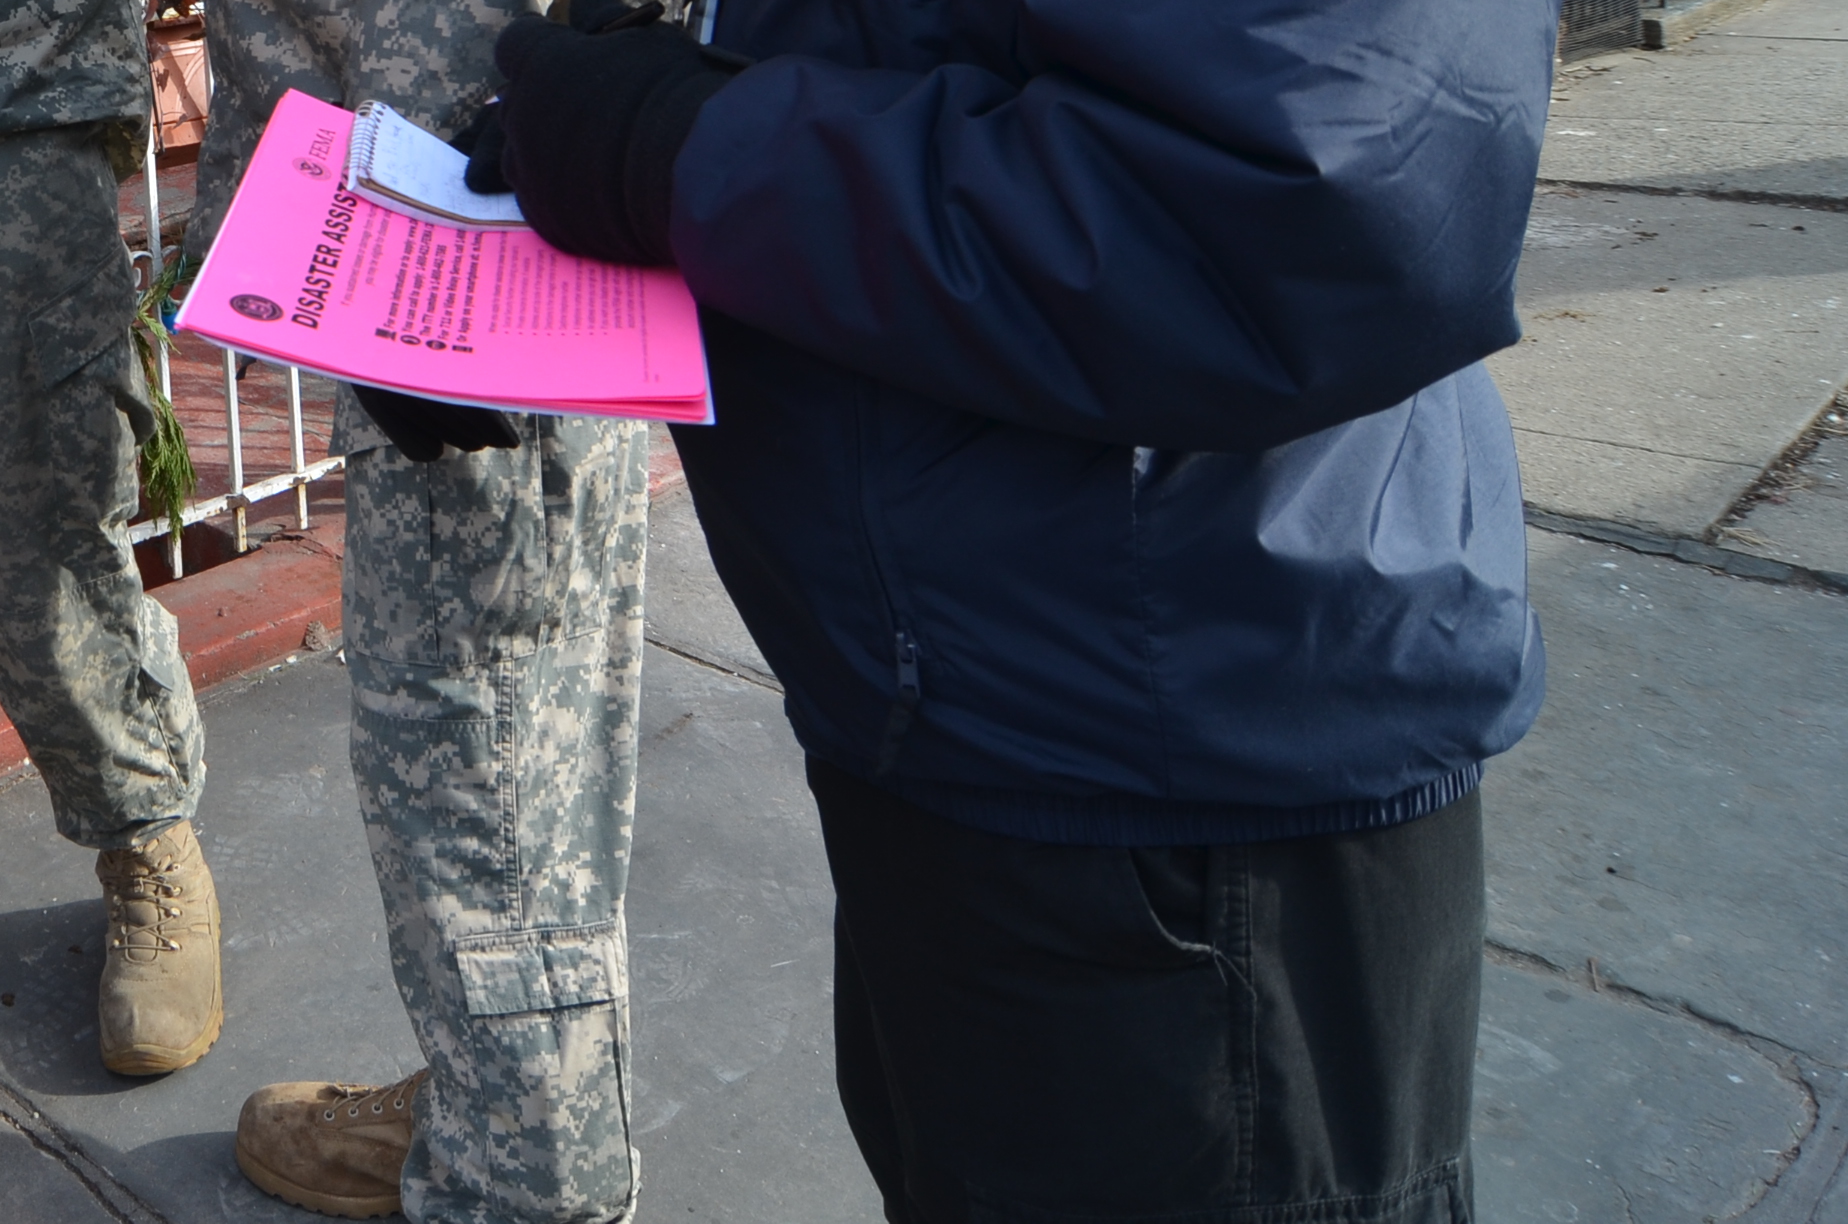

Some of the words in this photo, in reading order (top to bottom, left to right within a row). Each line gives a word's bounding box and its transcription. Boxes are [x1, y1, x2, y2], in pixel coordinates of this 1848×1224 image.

[308, 128, 336, 161] FEMA
[291, 244, 342, 330] DISASTER
[321, 180, 357, 245] ASSIST
[390, 268, 407, 301] information
[389, 302, 399, 317] more
[408, 297, 419, 308] call
[426, 292, 438, 313] number
[407, 309, 416, 320] can
